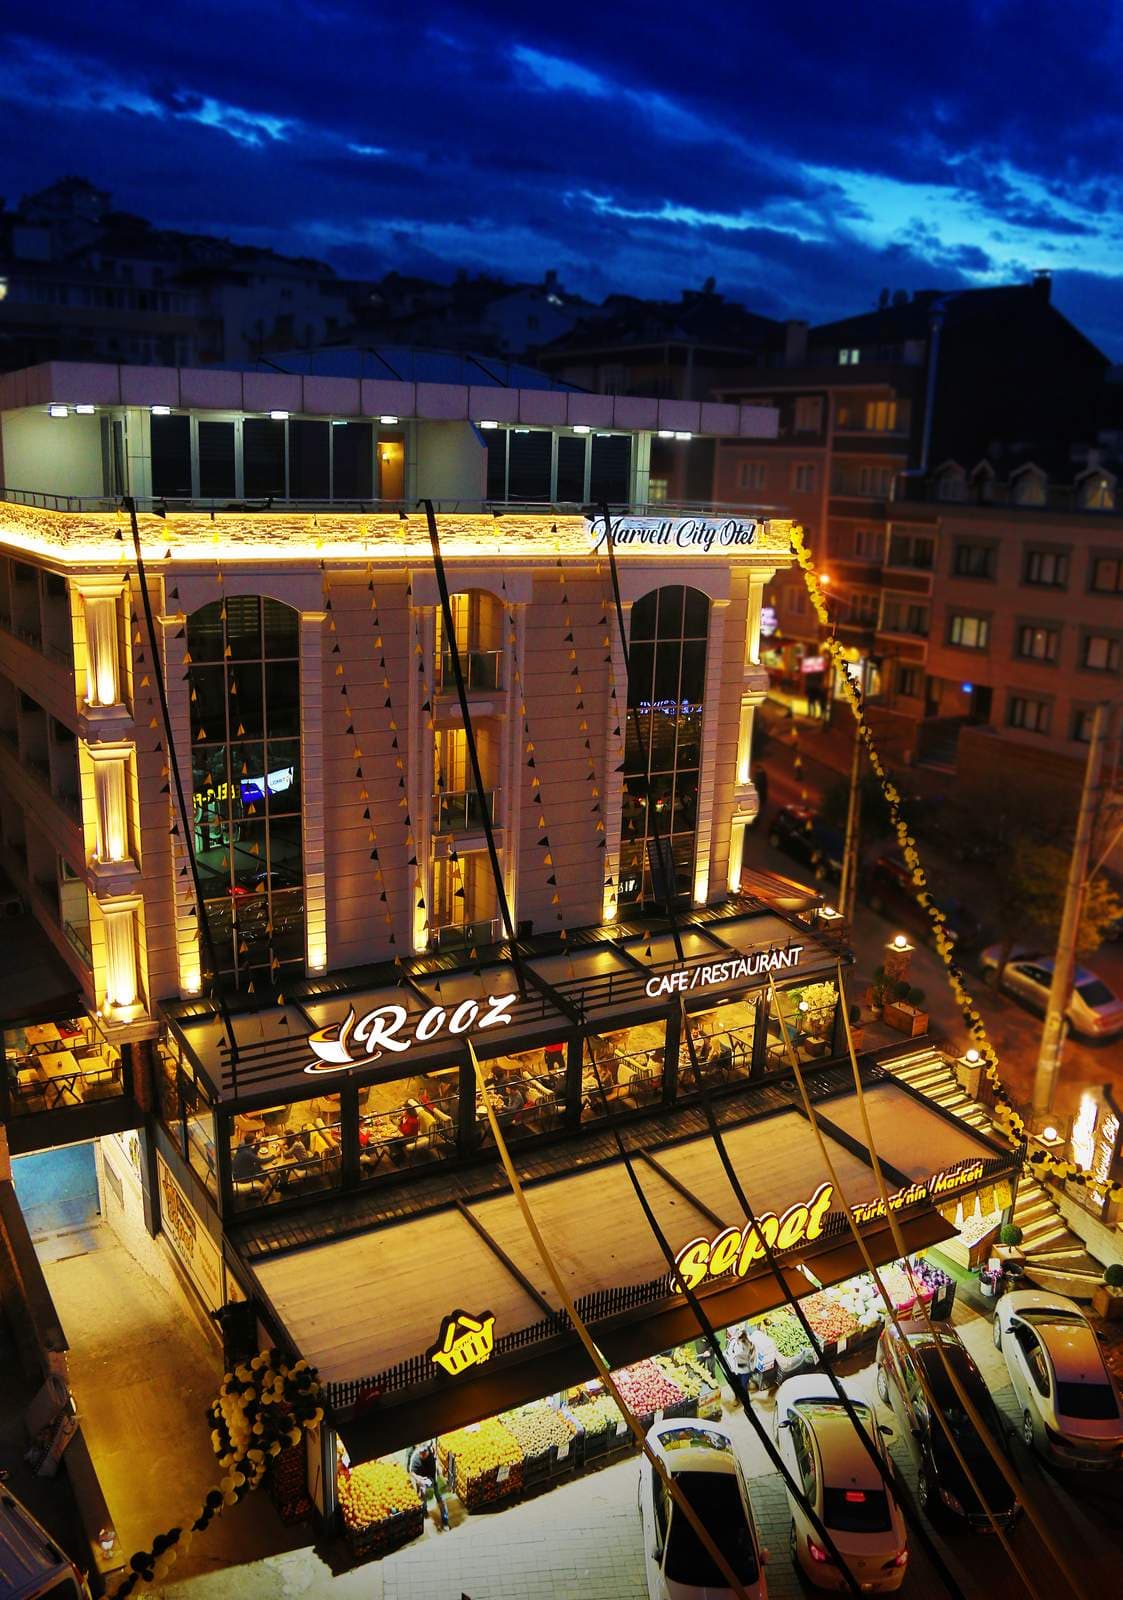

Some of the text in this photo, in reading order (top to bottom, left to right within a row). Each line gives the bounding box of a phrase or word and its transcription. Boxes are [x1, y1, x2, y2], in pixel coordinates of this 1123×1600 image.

[591, 517, 756, 552] Marvell City Otel
[852, 1163, 984, 1223] Türkye'nin Marketi
